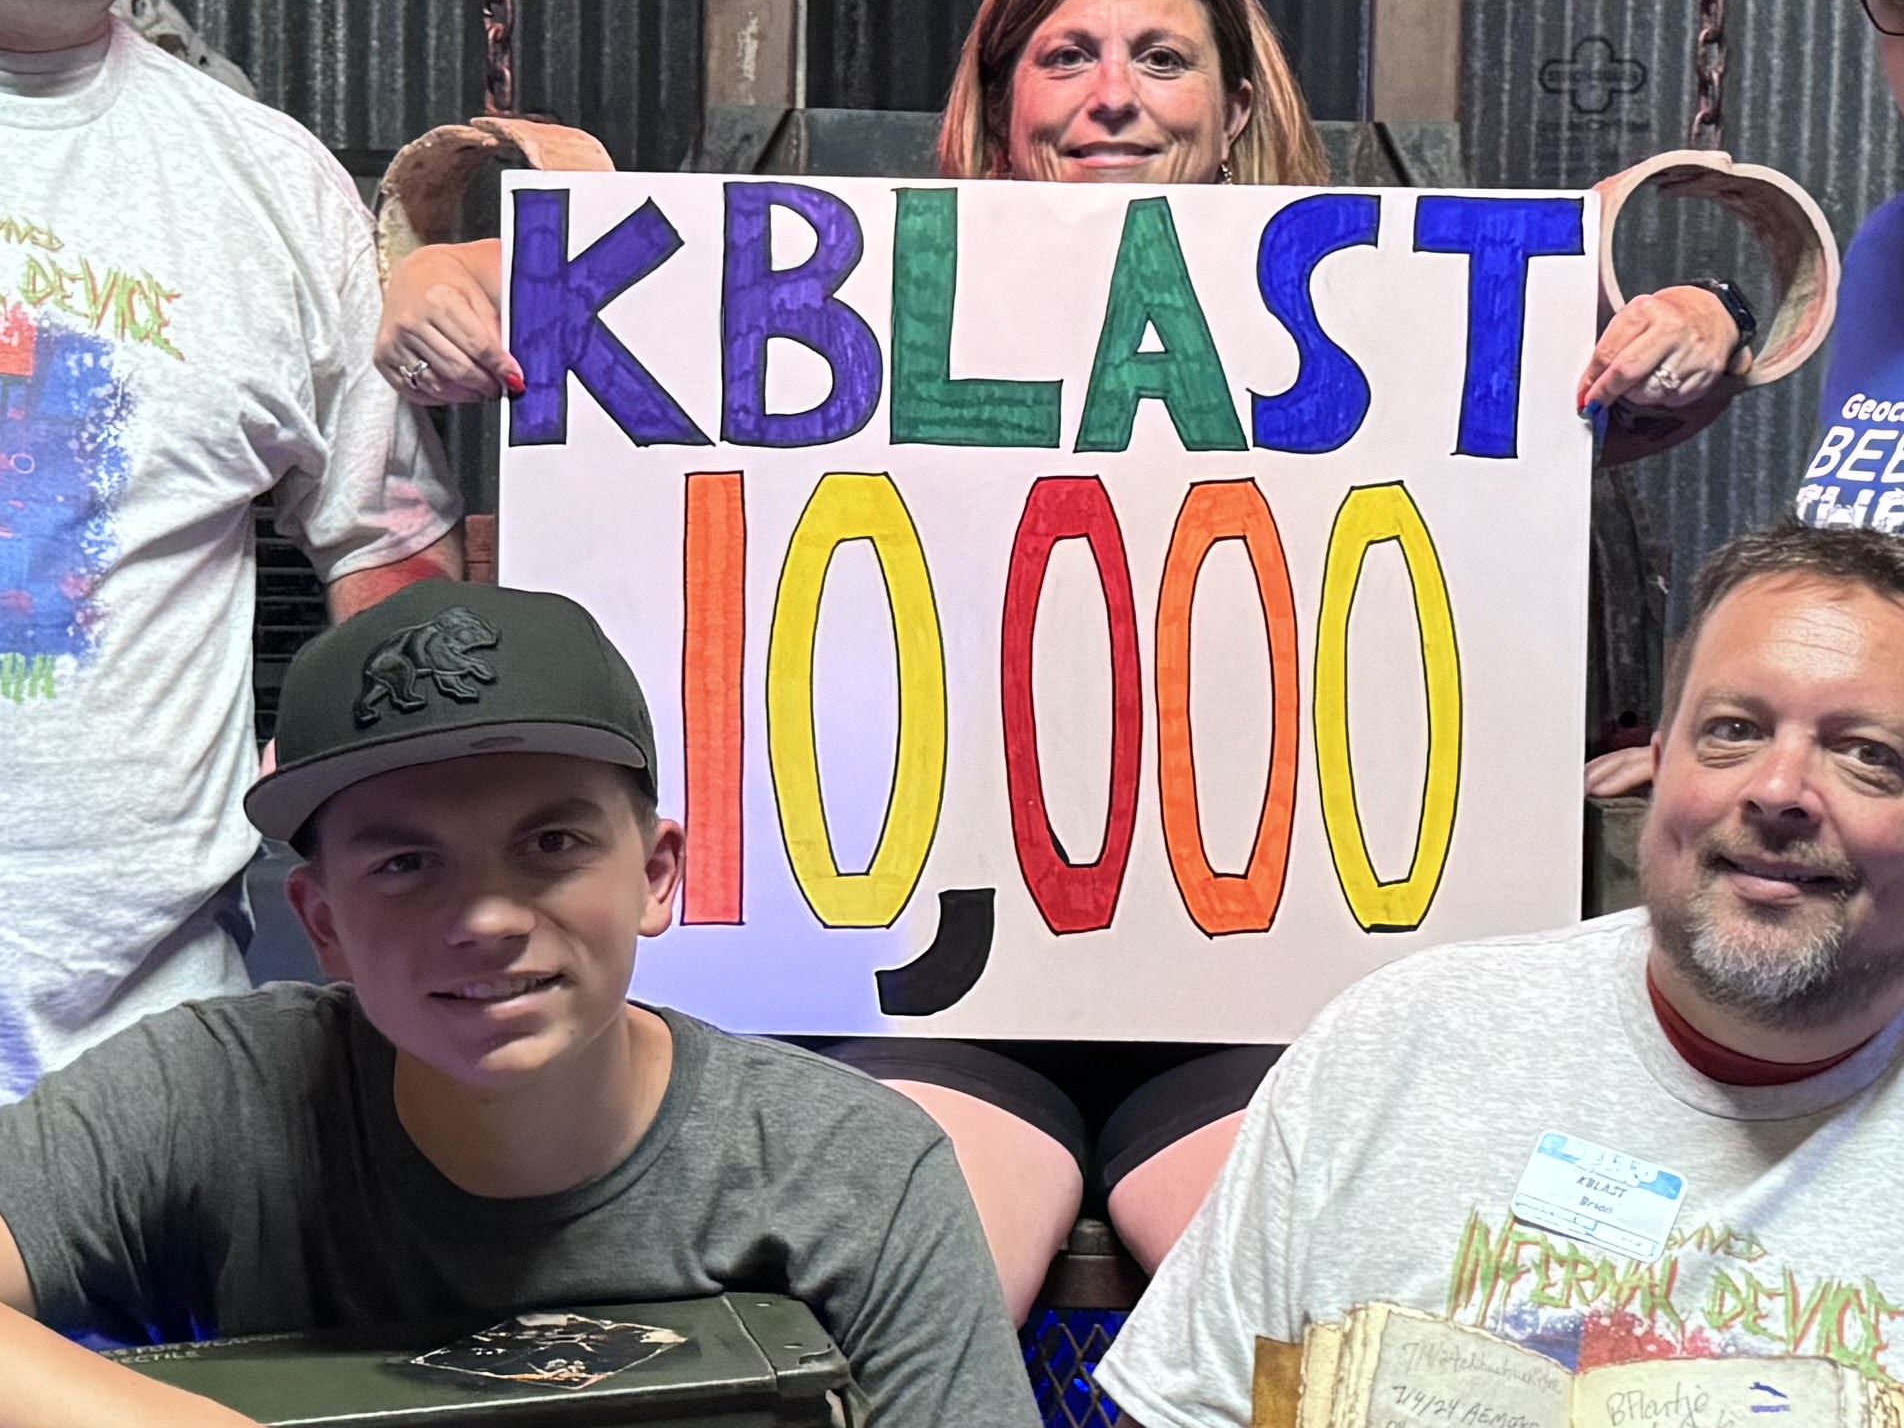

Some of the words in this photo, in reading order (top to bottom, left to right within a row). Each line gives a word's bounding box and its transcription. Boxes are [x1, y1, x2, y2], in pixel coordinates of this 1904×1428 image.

[22, 253, 188, 363] DEVICE
[507, 180, 1585, 459] KBLAST
[679, 470, 1464, 1017] 10,000
[1576, 1175, 1628, 1199] KBLAST
[1446, 1206, 1690, 1358] INFERNAL
